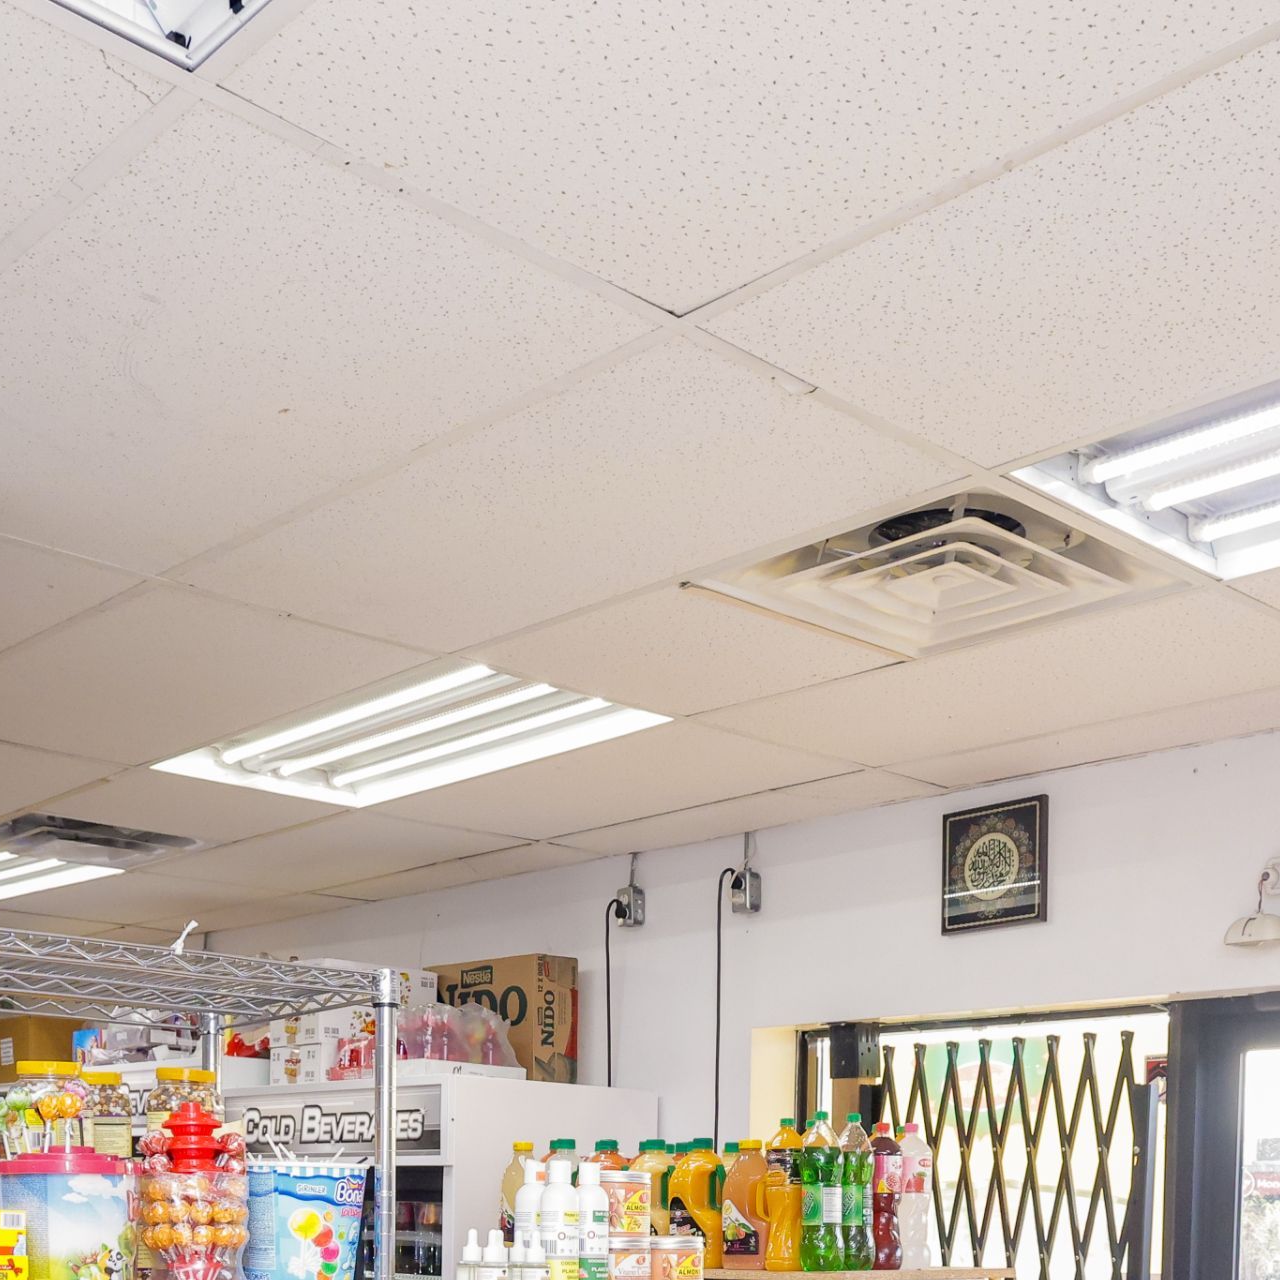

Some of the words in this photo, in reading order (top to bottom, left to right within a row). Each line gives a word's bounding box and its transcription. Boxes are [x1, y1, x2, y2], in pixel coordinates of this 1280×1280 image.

[541, 990, 555, 1047] NIDO
[243, 1108, 295, 1143] COLD
[302, 1105, 425, 1143] BEVERAES
